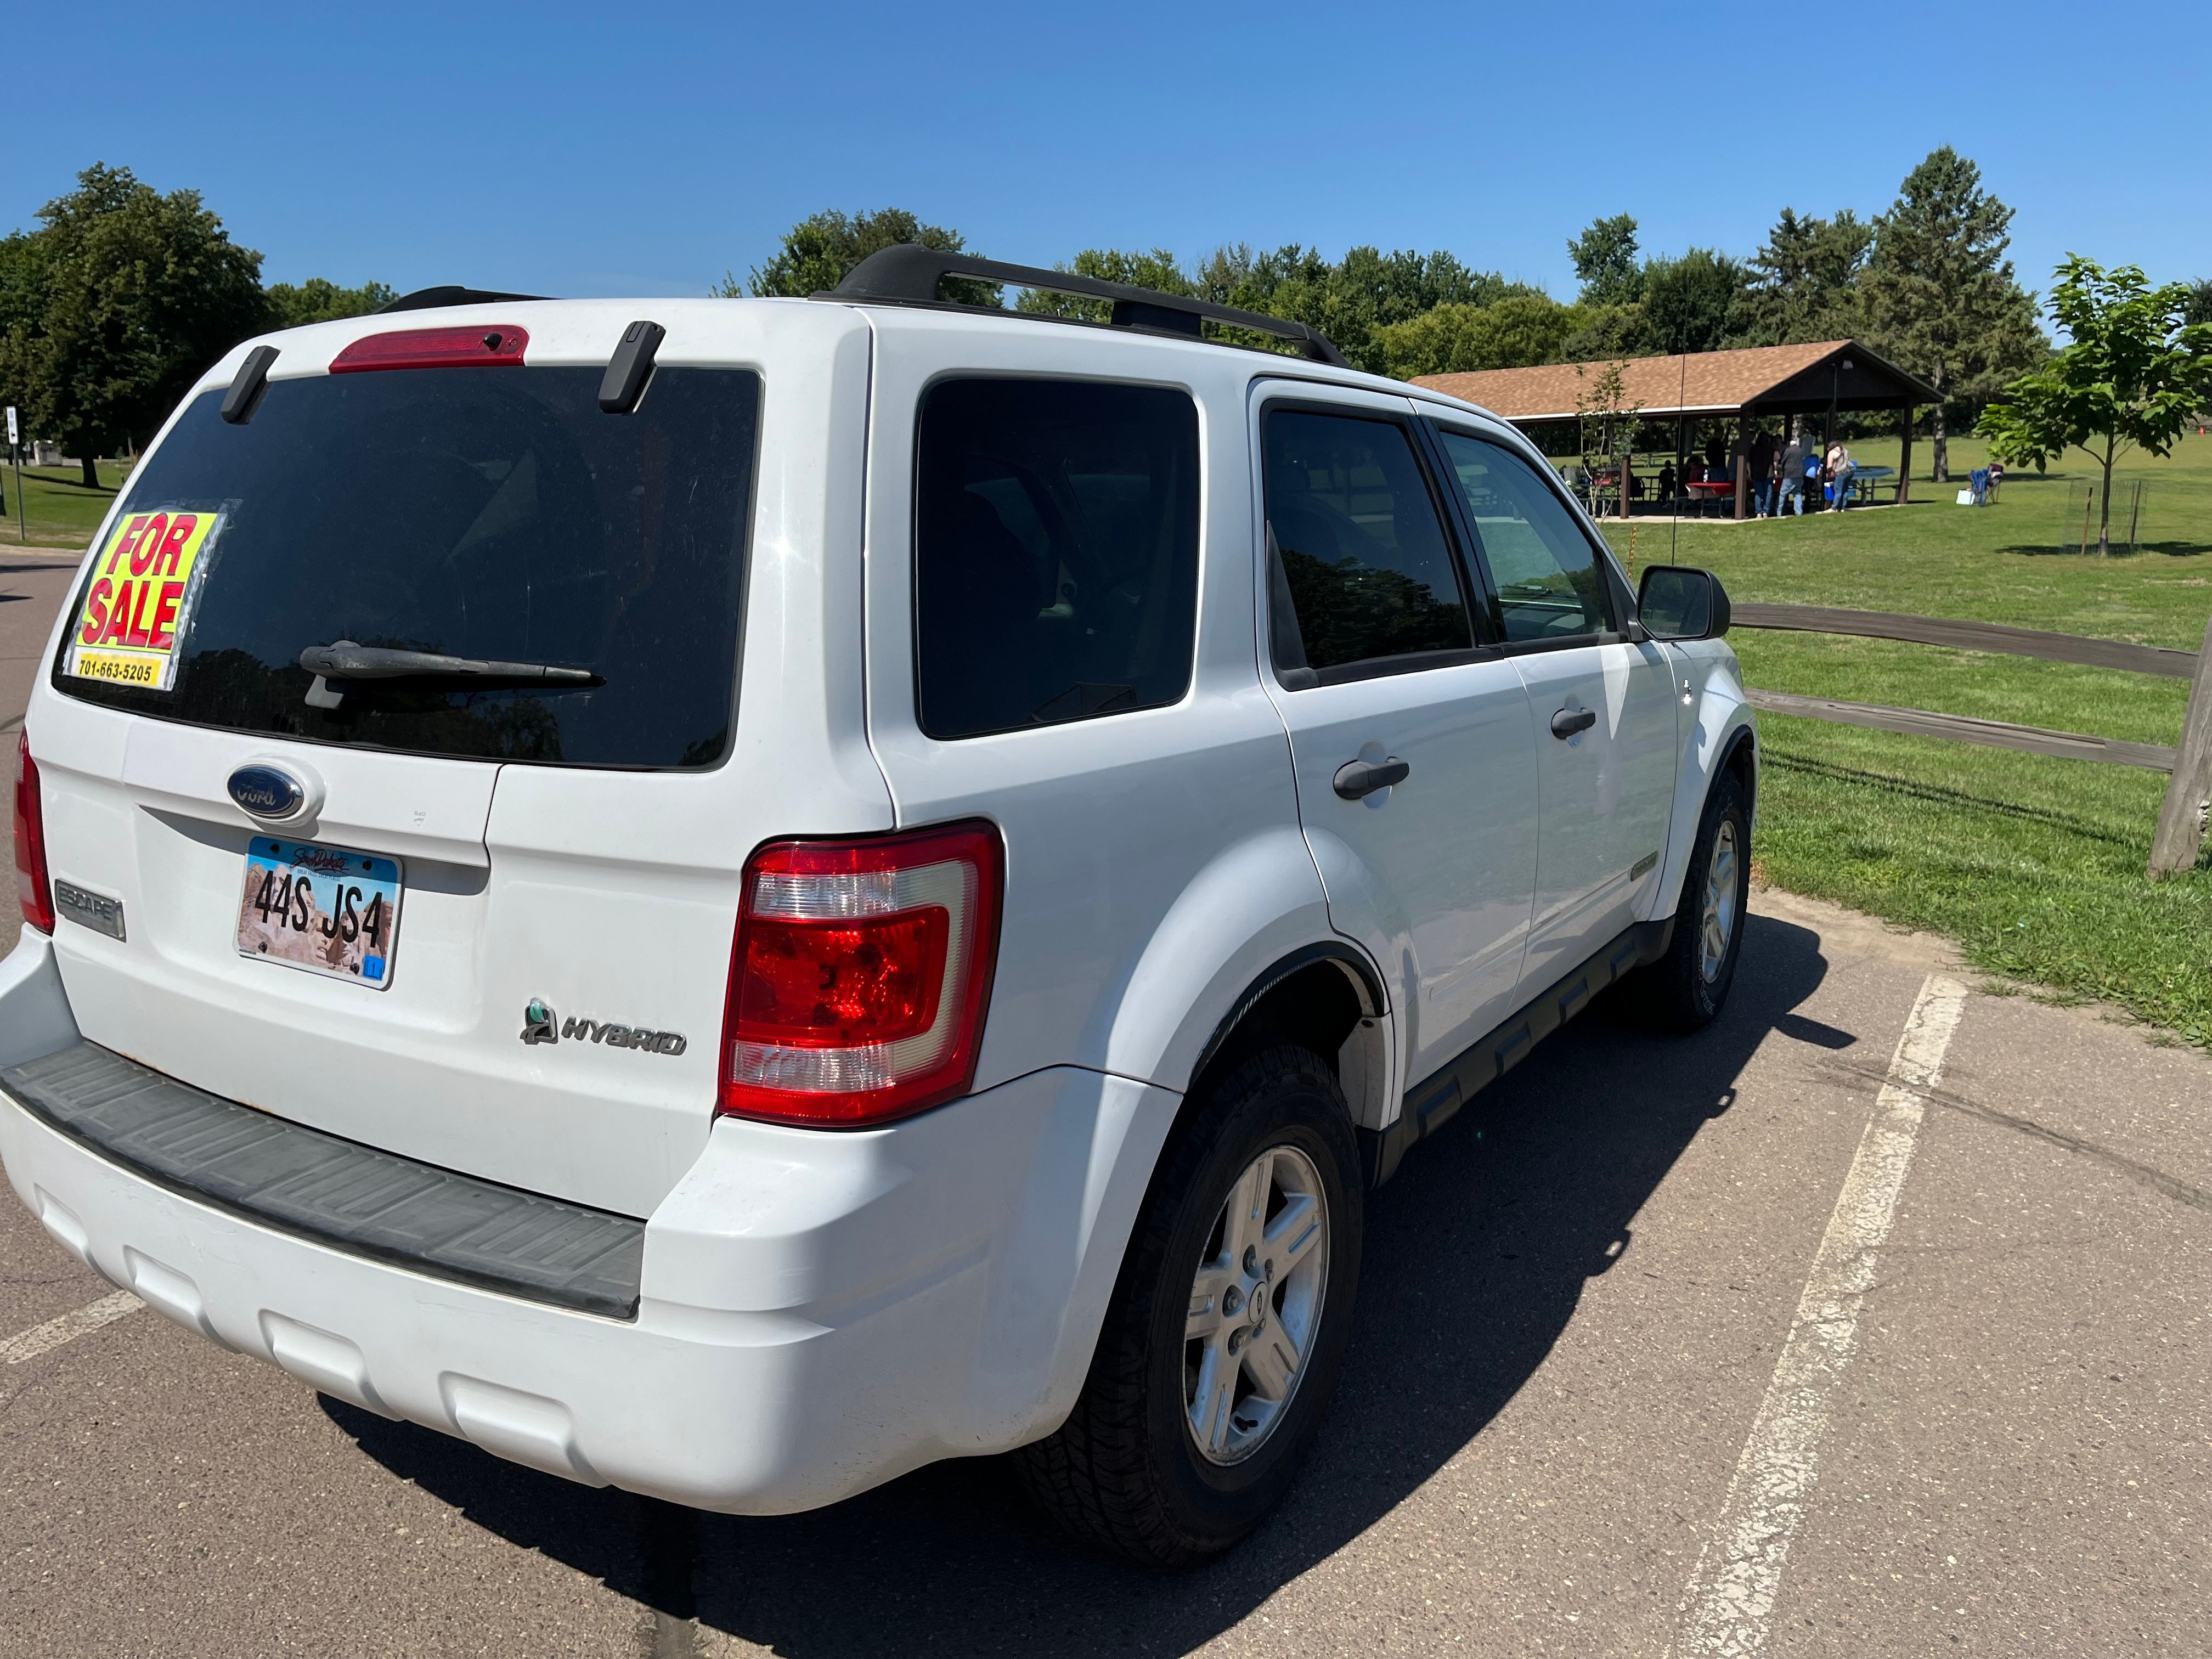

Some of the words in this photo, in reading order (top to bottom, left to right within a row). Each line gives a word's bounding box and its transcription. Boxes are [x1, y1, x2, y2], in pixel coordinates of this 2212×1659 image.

[106, 512, 198, 577] FOR
[82, 578, 185, 650] SALE
[79, 660, 152, 681] 701-663-5205
[255, 870, 312, 932] 44S
[322, 884, 382, 948] JS4
[561, 1015, 687, 1056] HYBRID
